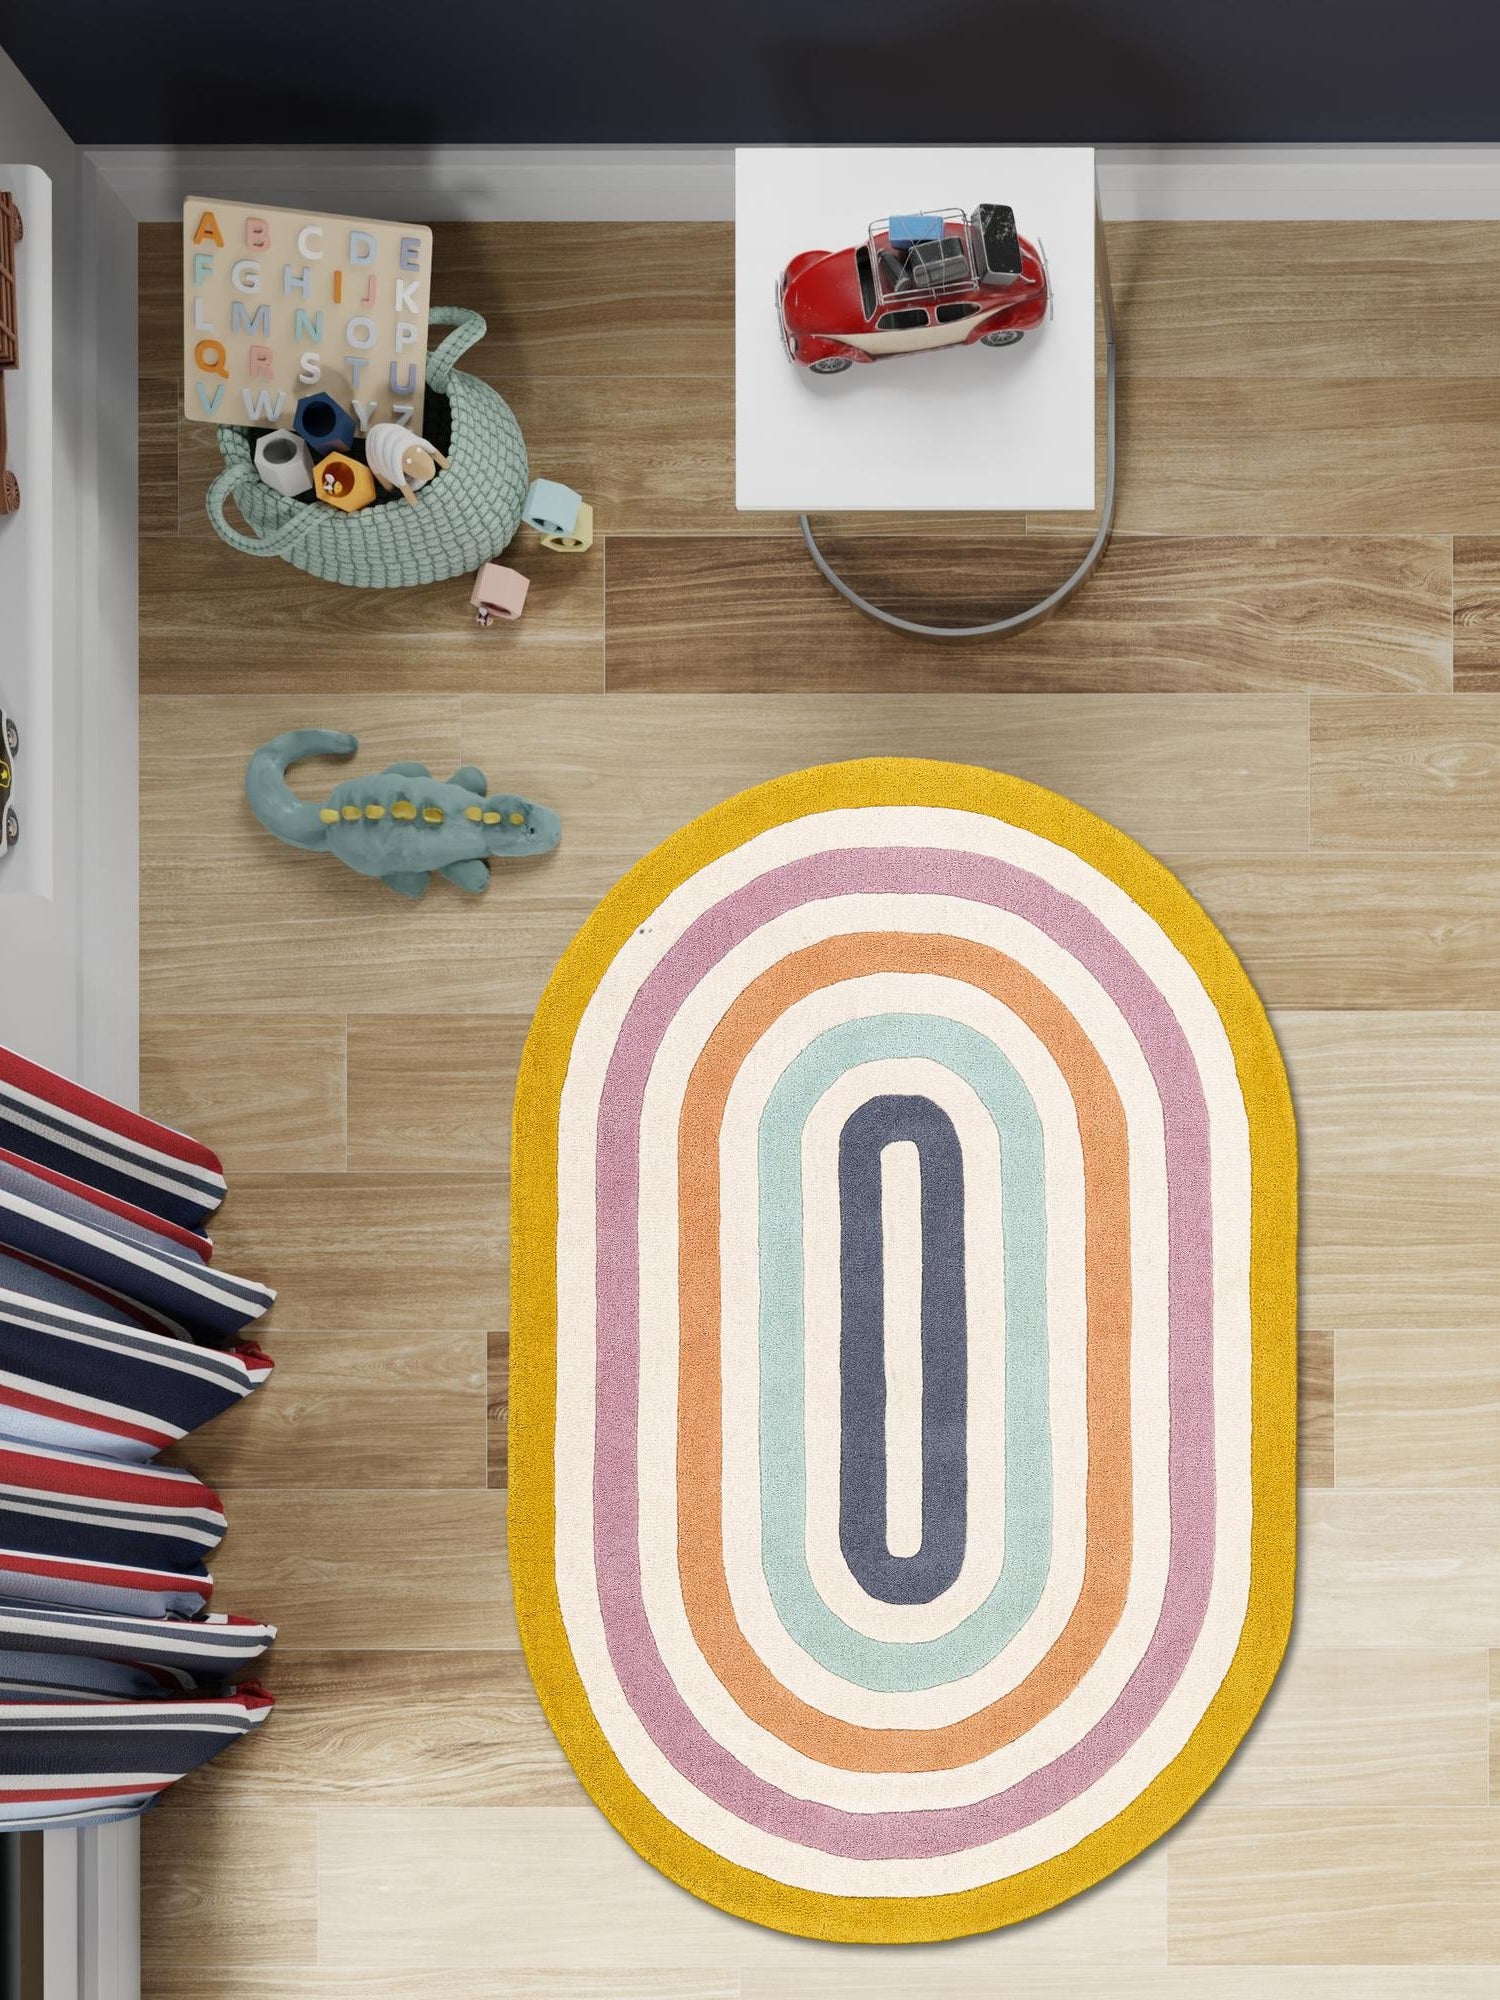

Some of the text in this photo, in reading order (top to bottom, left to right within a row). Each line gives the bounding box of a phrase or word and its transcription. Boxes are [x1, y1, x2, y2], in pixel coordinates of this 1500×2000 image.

[193, 212, 421, 272] A B C D E
[193, 253, 420, 314] F G H I J K
[194, 296, 417, 352] L M N O P
[194, 339, 417, 396] Q R S T U
[196, 382, 225, 417] V
[242, 388, 286, 422] W
[352, 399, 377, 432] Y
